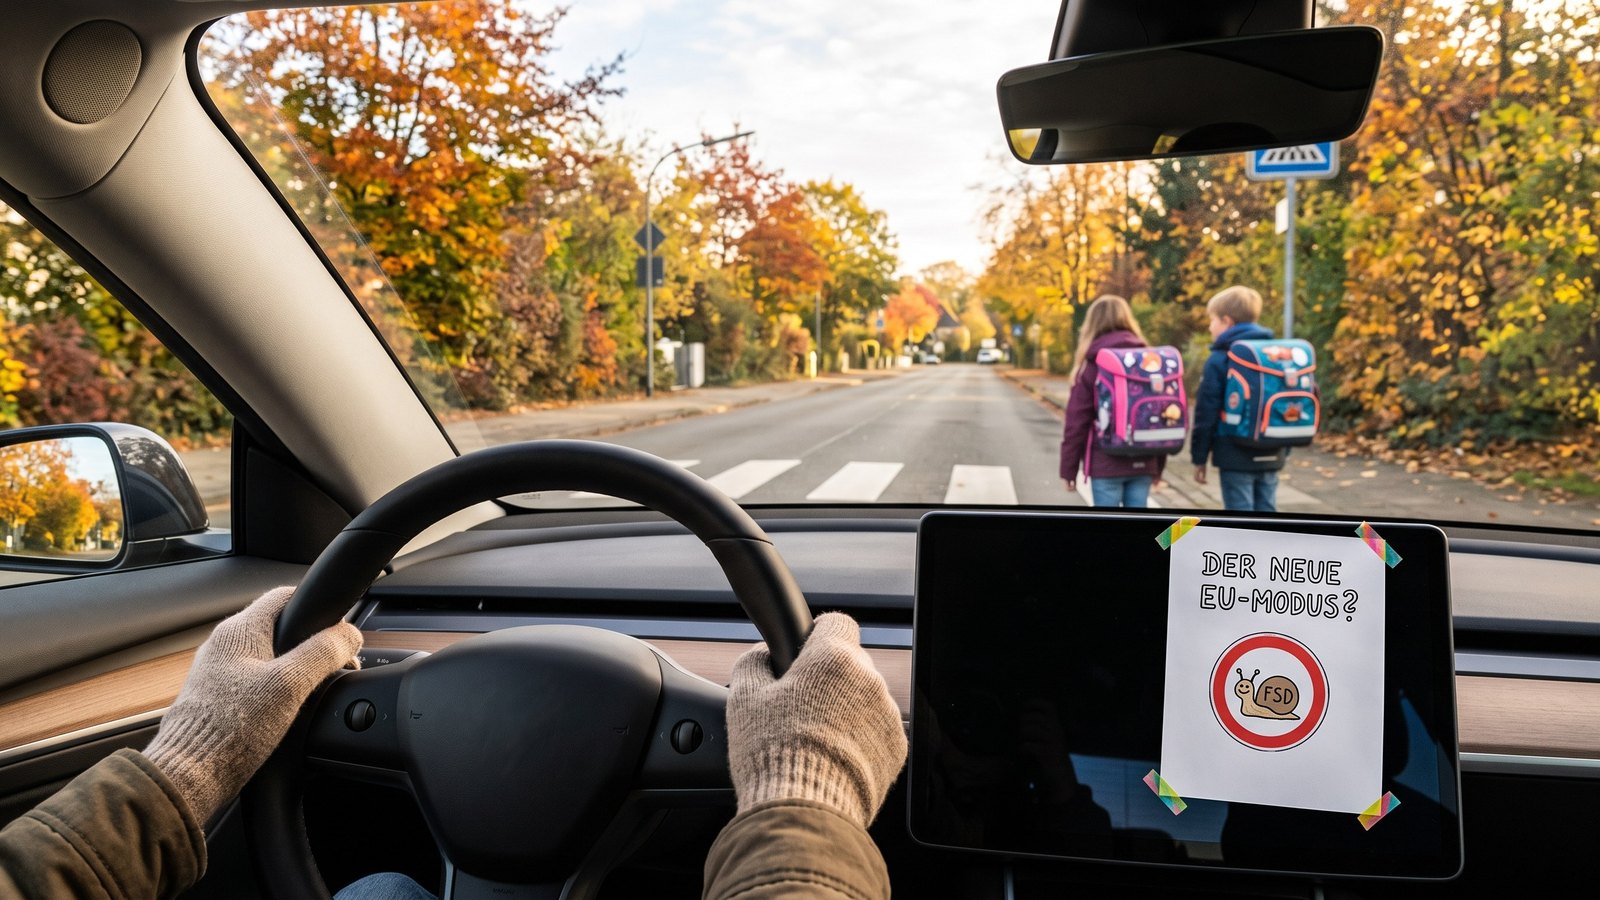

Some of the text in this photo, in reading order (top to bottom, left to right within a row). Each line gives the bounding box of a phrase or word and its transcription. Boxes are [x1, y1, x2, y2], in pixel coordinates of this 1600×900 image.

[1202, 551, 1342, 585] DER NEUE
[1200, 584, 1358, 622] EU-MODUS?
[1263, 685, 1294, 705] FSD
